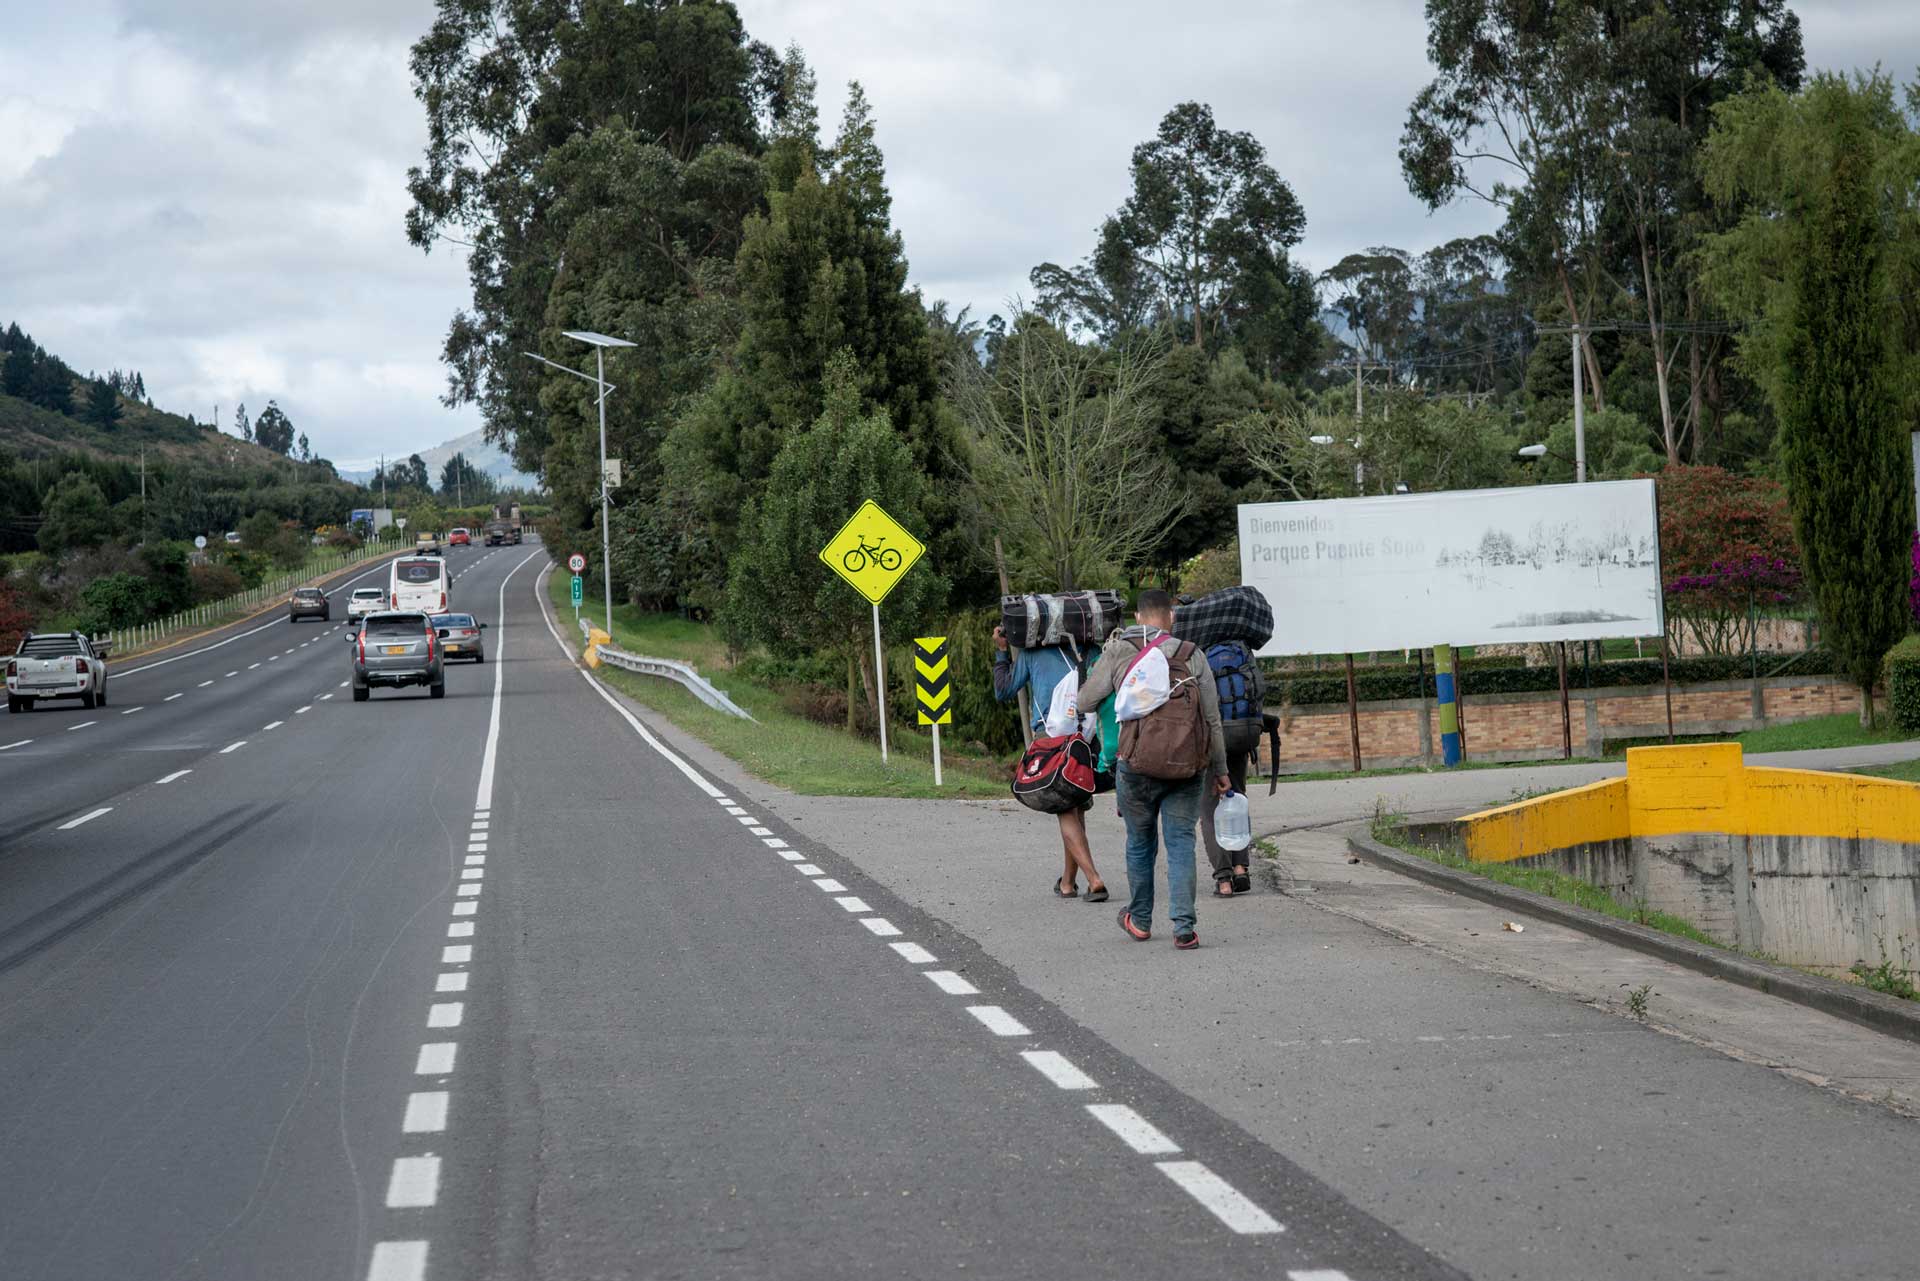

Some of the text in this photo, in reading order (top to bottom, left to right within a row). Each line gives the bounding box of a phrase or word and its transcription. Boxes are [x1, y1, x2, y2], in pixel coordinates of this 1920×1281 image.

[1249, 515, 1334, 534] Bienvenidos
[1251, 543, 1310, 564] Parque
[1315, 540, 1375, 560] Puente
[571, 559, 582, 567] 80
